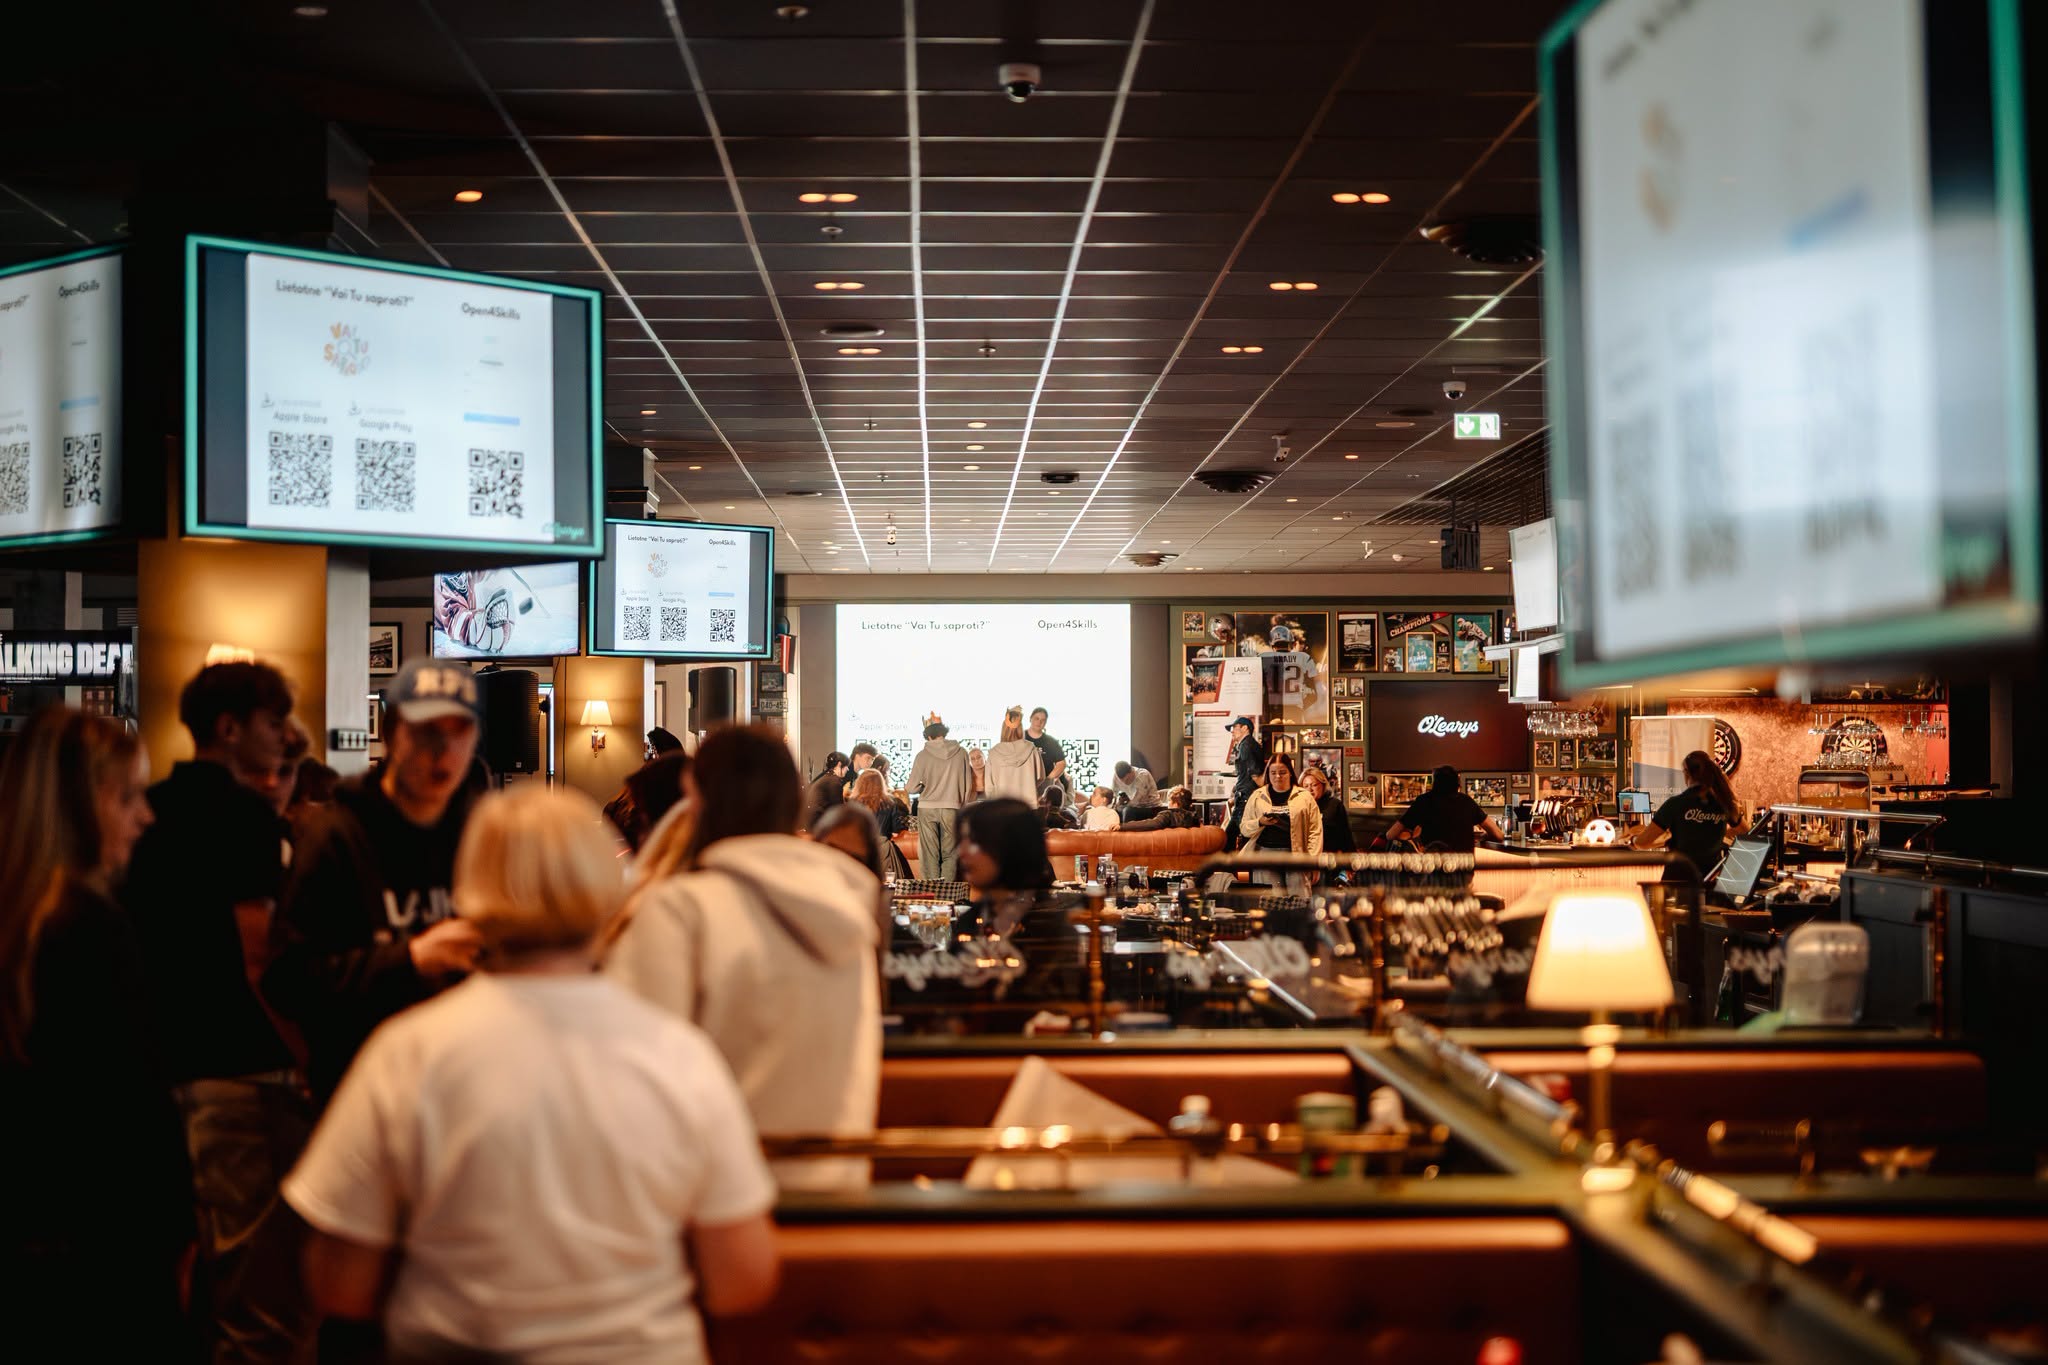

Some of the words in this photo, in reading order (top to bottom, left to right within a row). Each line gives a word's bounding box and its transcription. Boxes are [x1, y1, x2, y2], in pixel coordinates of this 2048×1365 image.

[275, 279, 321, 296] Lietotne
[350, 288, 363, 301] Tu
[461, 302, 520, 320] Open4Skills
[628, 534, 648, 542] Lietotne
[708, 538, 737, 546] Open4Skills
[861, 620, 903, 630] Lietotne
[929, 620, 941, 630] Tu
[1037, 619, 1098, 631] Open4Skills
[1389, 614, 1431, 637] CHAMPIONS
[0, 642, 74, 674] LKING
[1273, 655, 1298, 663] BRADY
[1272, 665, 1302, 694] 12
[1417, 714, 1479, 739] O'Learys
